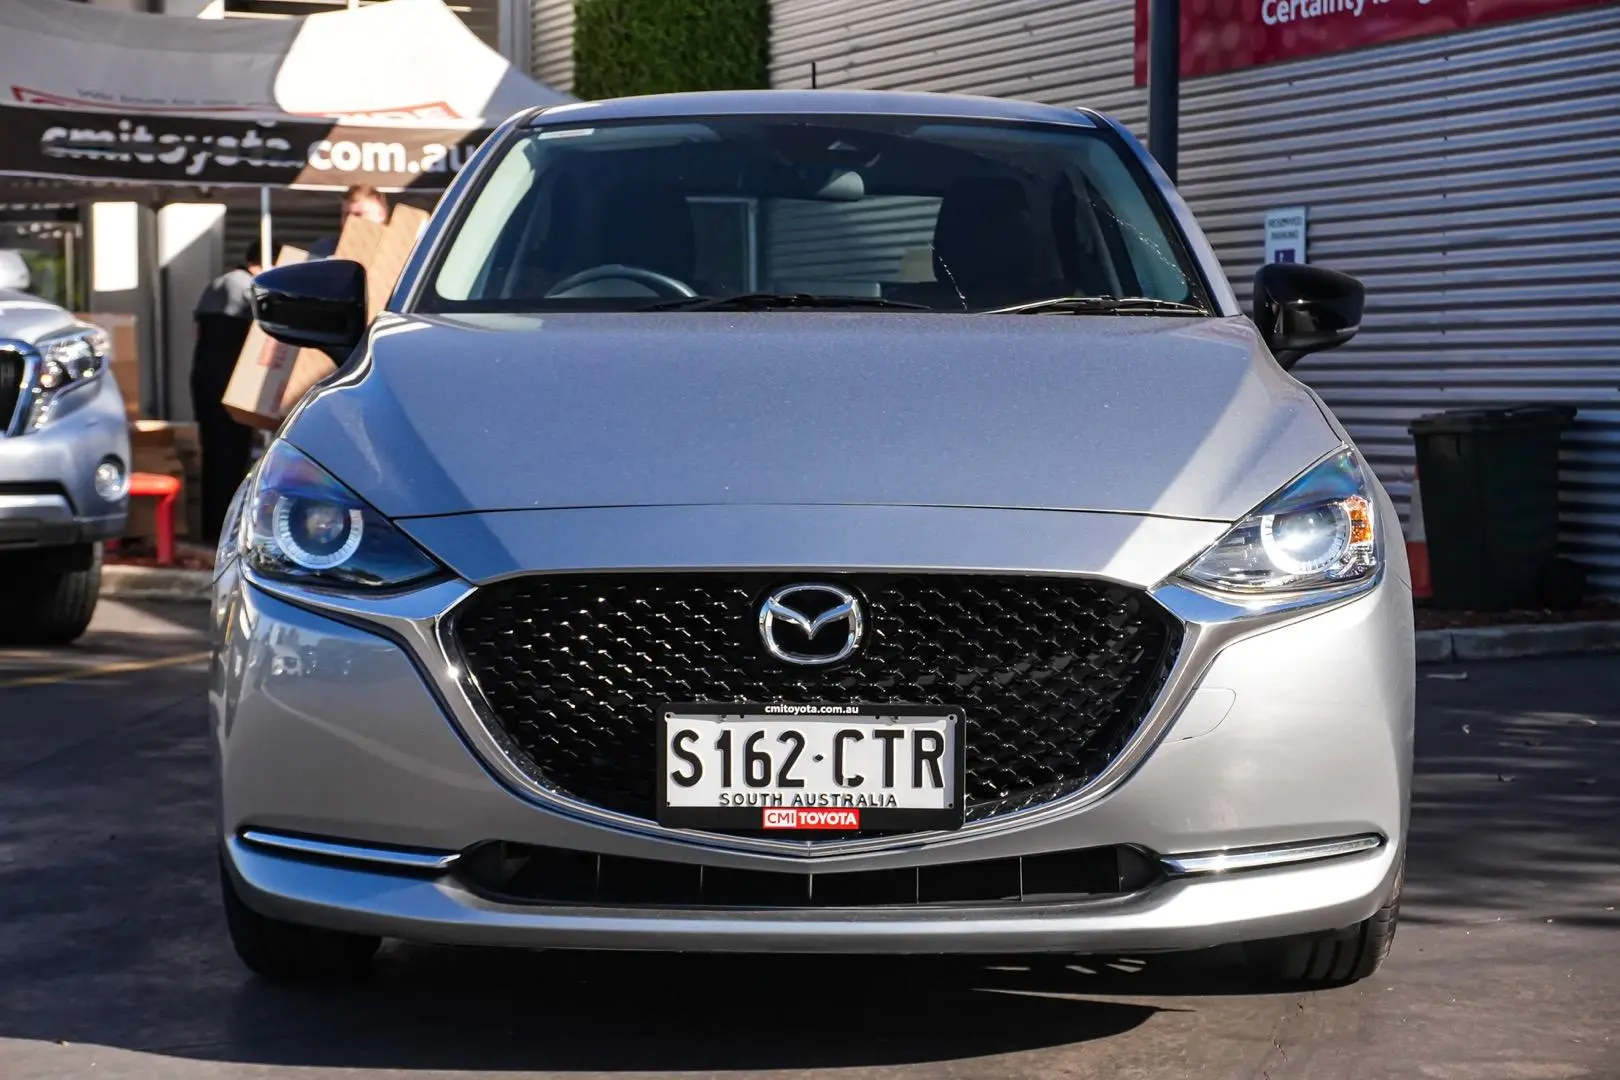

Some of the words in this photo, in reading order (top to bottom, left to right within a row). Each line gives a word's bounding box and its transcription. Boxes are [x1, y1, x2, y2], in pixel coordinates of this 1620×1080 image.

[765, 704, 859, 716] cmitoyota.com.au
[719, 793, 783, 807] SOUTH
[790, 793, 898, 807] AUSTRALIA
[767, 812, 795, 826] CMI
[797, 812, 858, 826] TOYOTA
